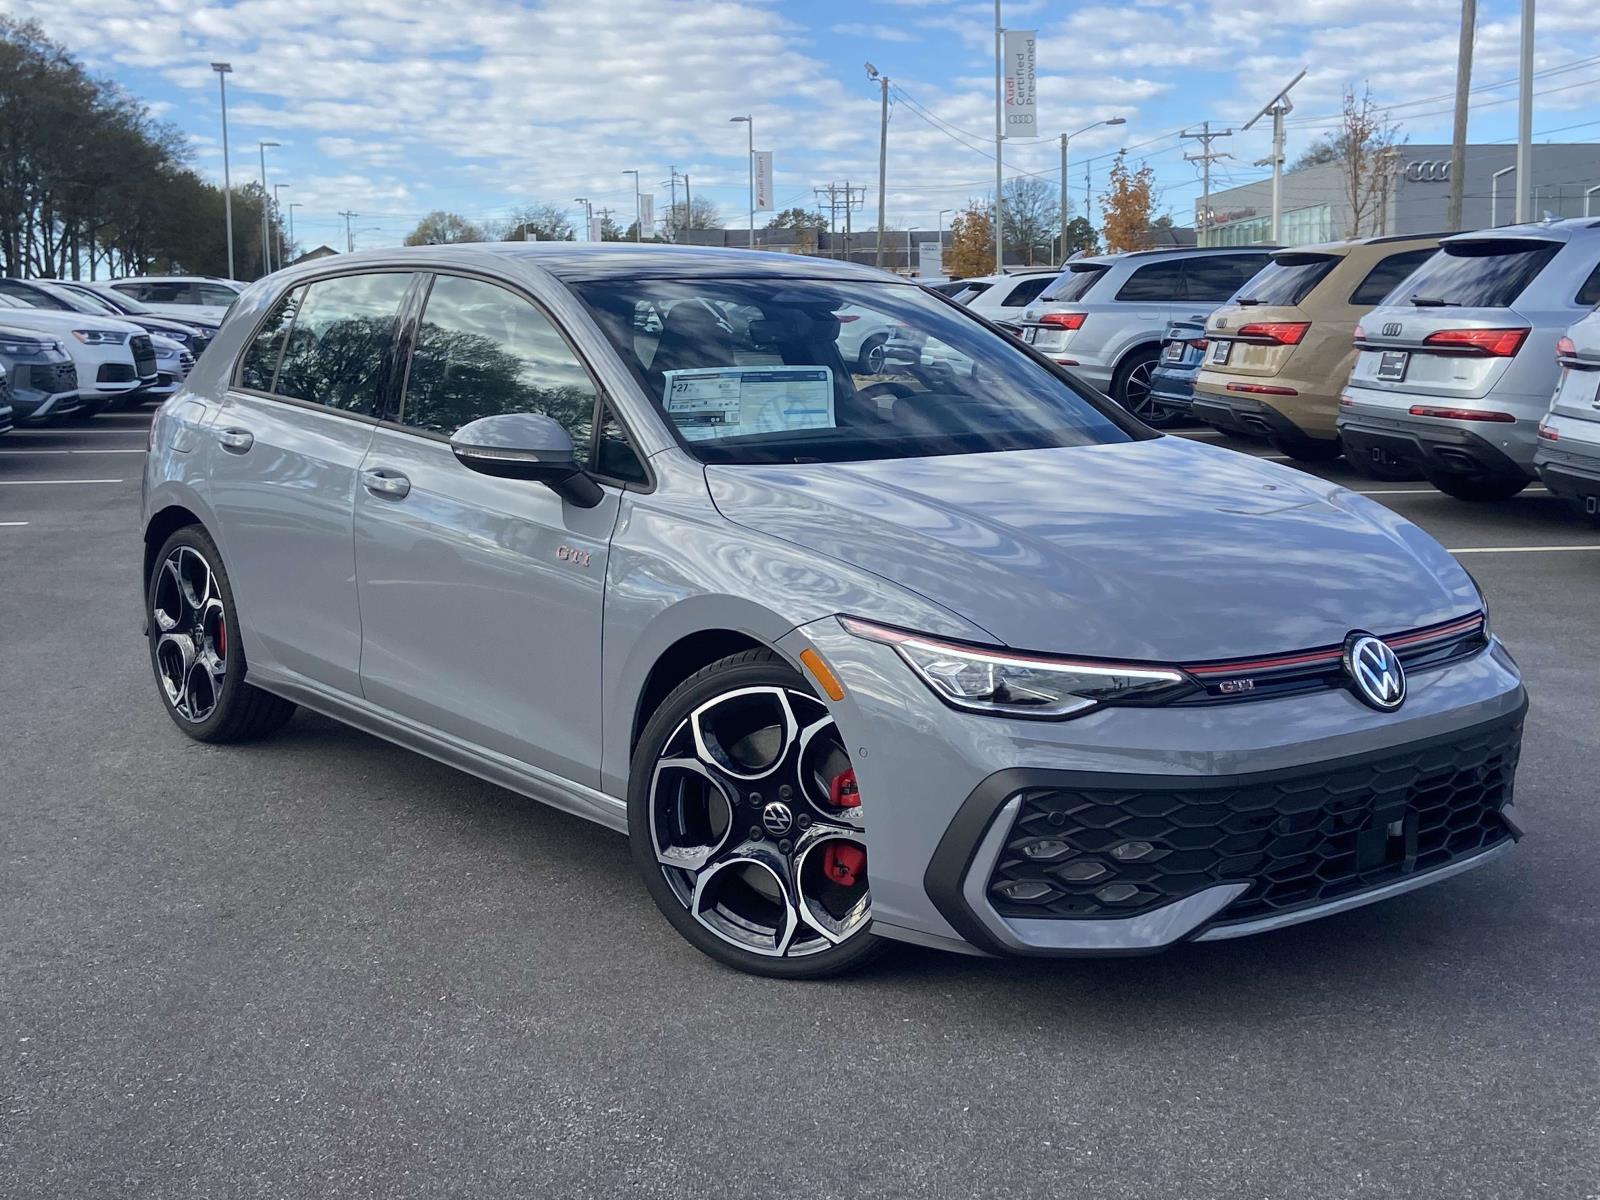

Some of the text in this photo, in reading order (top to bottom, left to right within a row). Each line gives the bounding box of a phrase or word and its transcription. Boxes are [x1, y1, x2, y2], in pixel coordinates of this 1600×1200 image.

[1016, 53, 1025, 106] Certified
[1026, 39, 1035, 105] Pre-owned
[1006, 77, 1015, 106] Audi
[676, 383, 689, 392] 27
[555, 545, 592, 567] GTI
[1219, 679, 1255, 693] GTI
